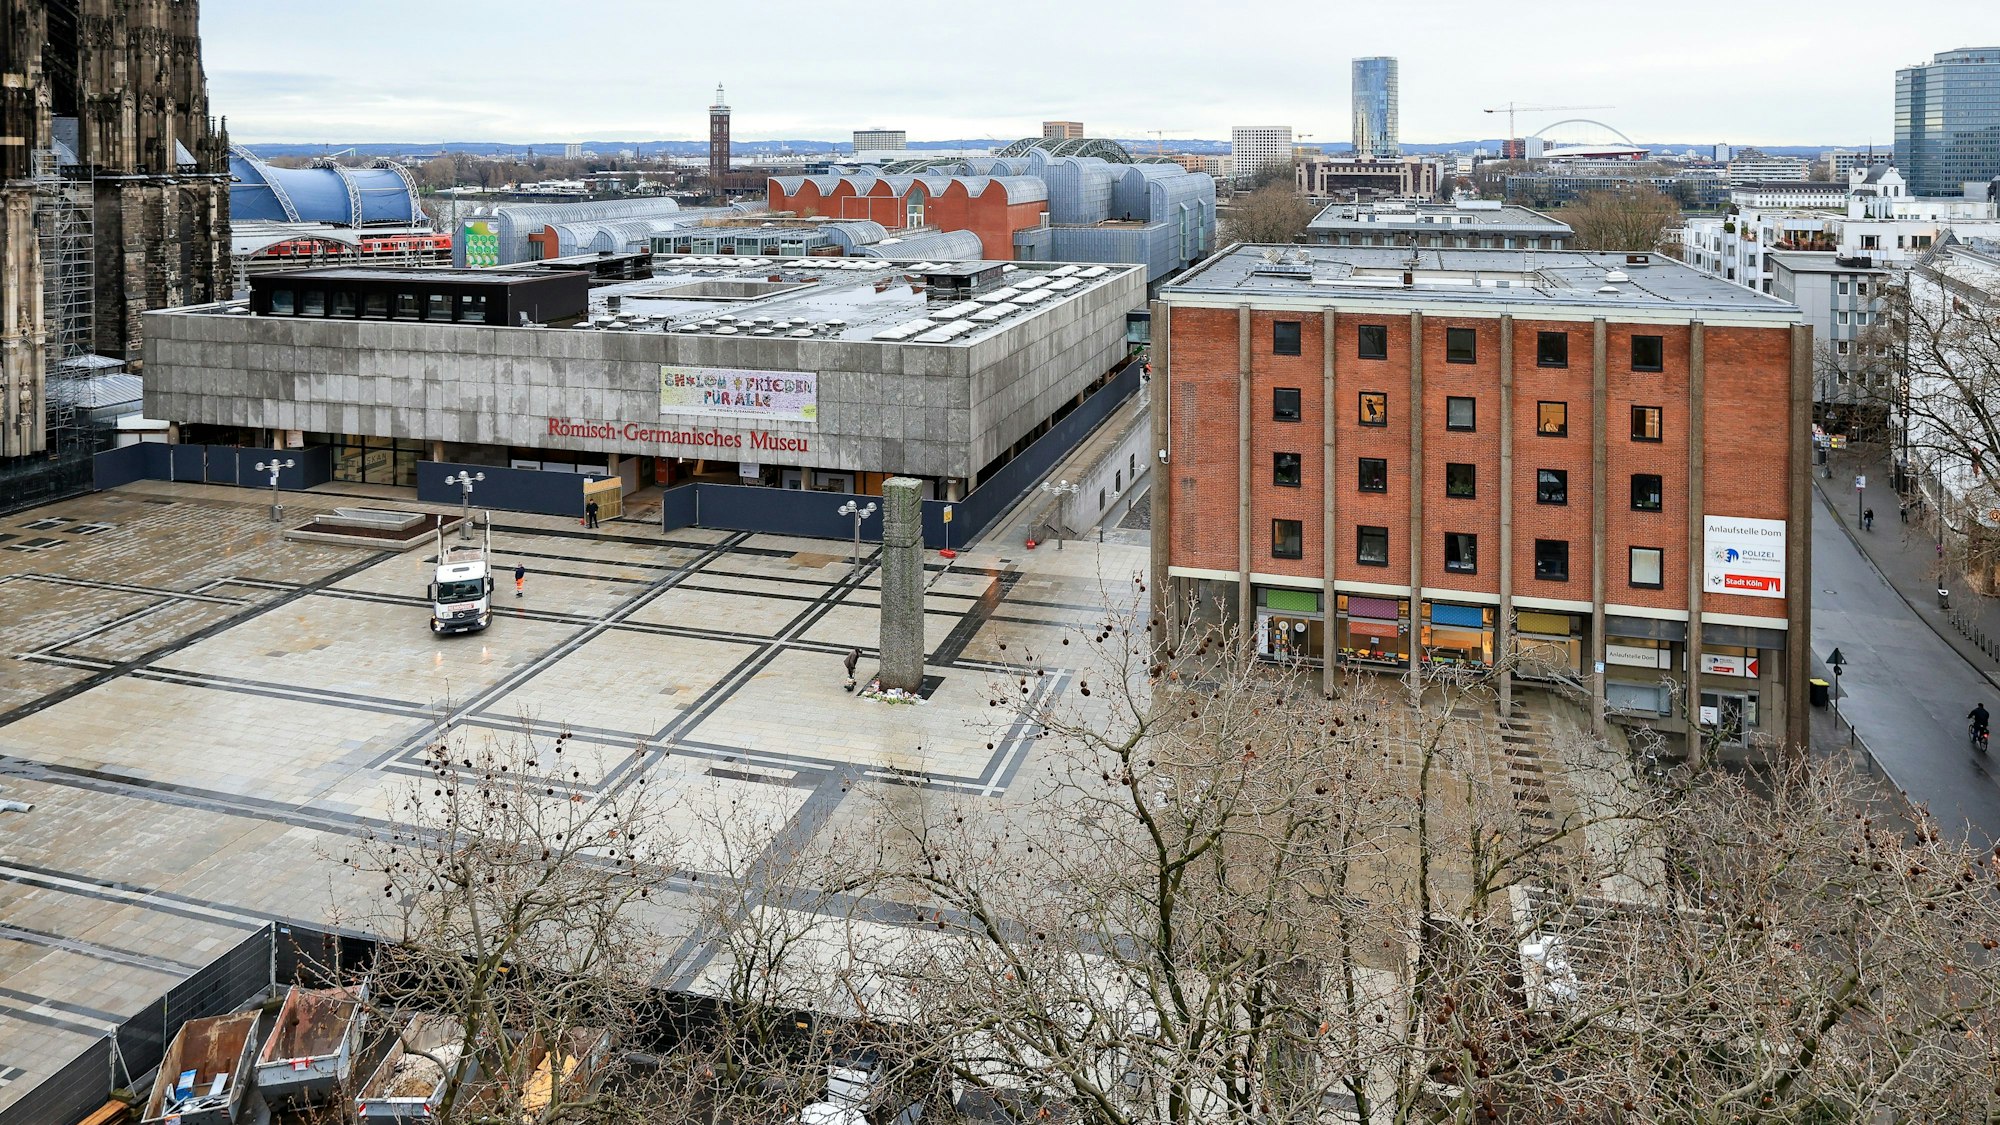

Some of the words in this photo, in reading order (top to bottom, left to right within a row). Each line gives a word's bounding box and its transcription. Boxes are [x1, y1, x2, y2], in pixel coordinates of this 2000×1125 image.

[746, 376, 812, 394] FRIEDEN
[735, 392, 770, 408] ALLE
[548, 417, 741, 448] Römisch-Germanisches
[1708, 525, 1759, 536] Anlaufstelle
[1761, 528, 1782, 537] Dom
[1742, 550, 1774, 558] POLIZEI
[1726, 578, 1745, 586] Stadt
[1746, 579, 1763, 587] Köln
[1609, 651, 1641, 660] Anlaufstelle
